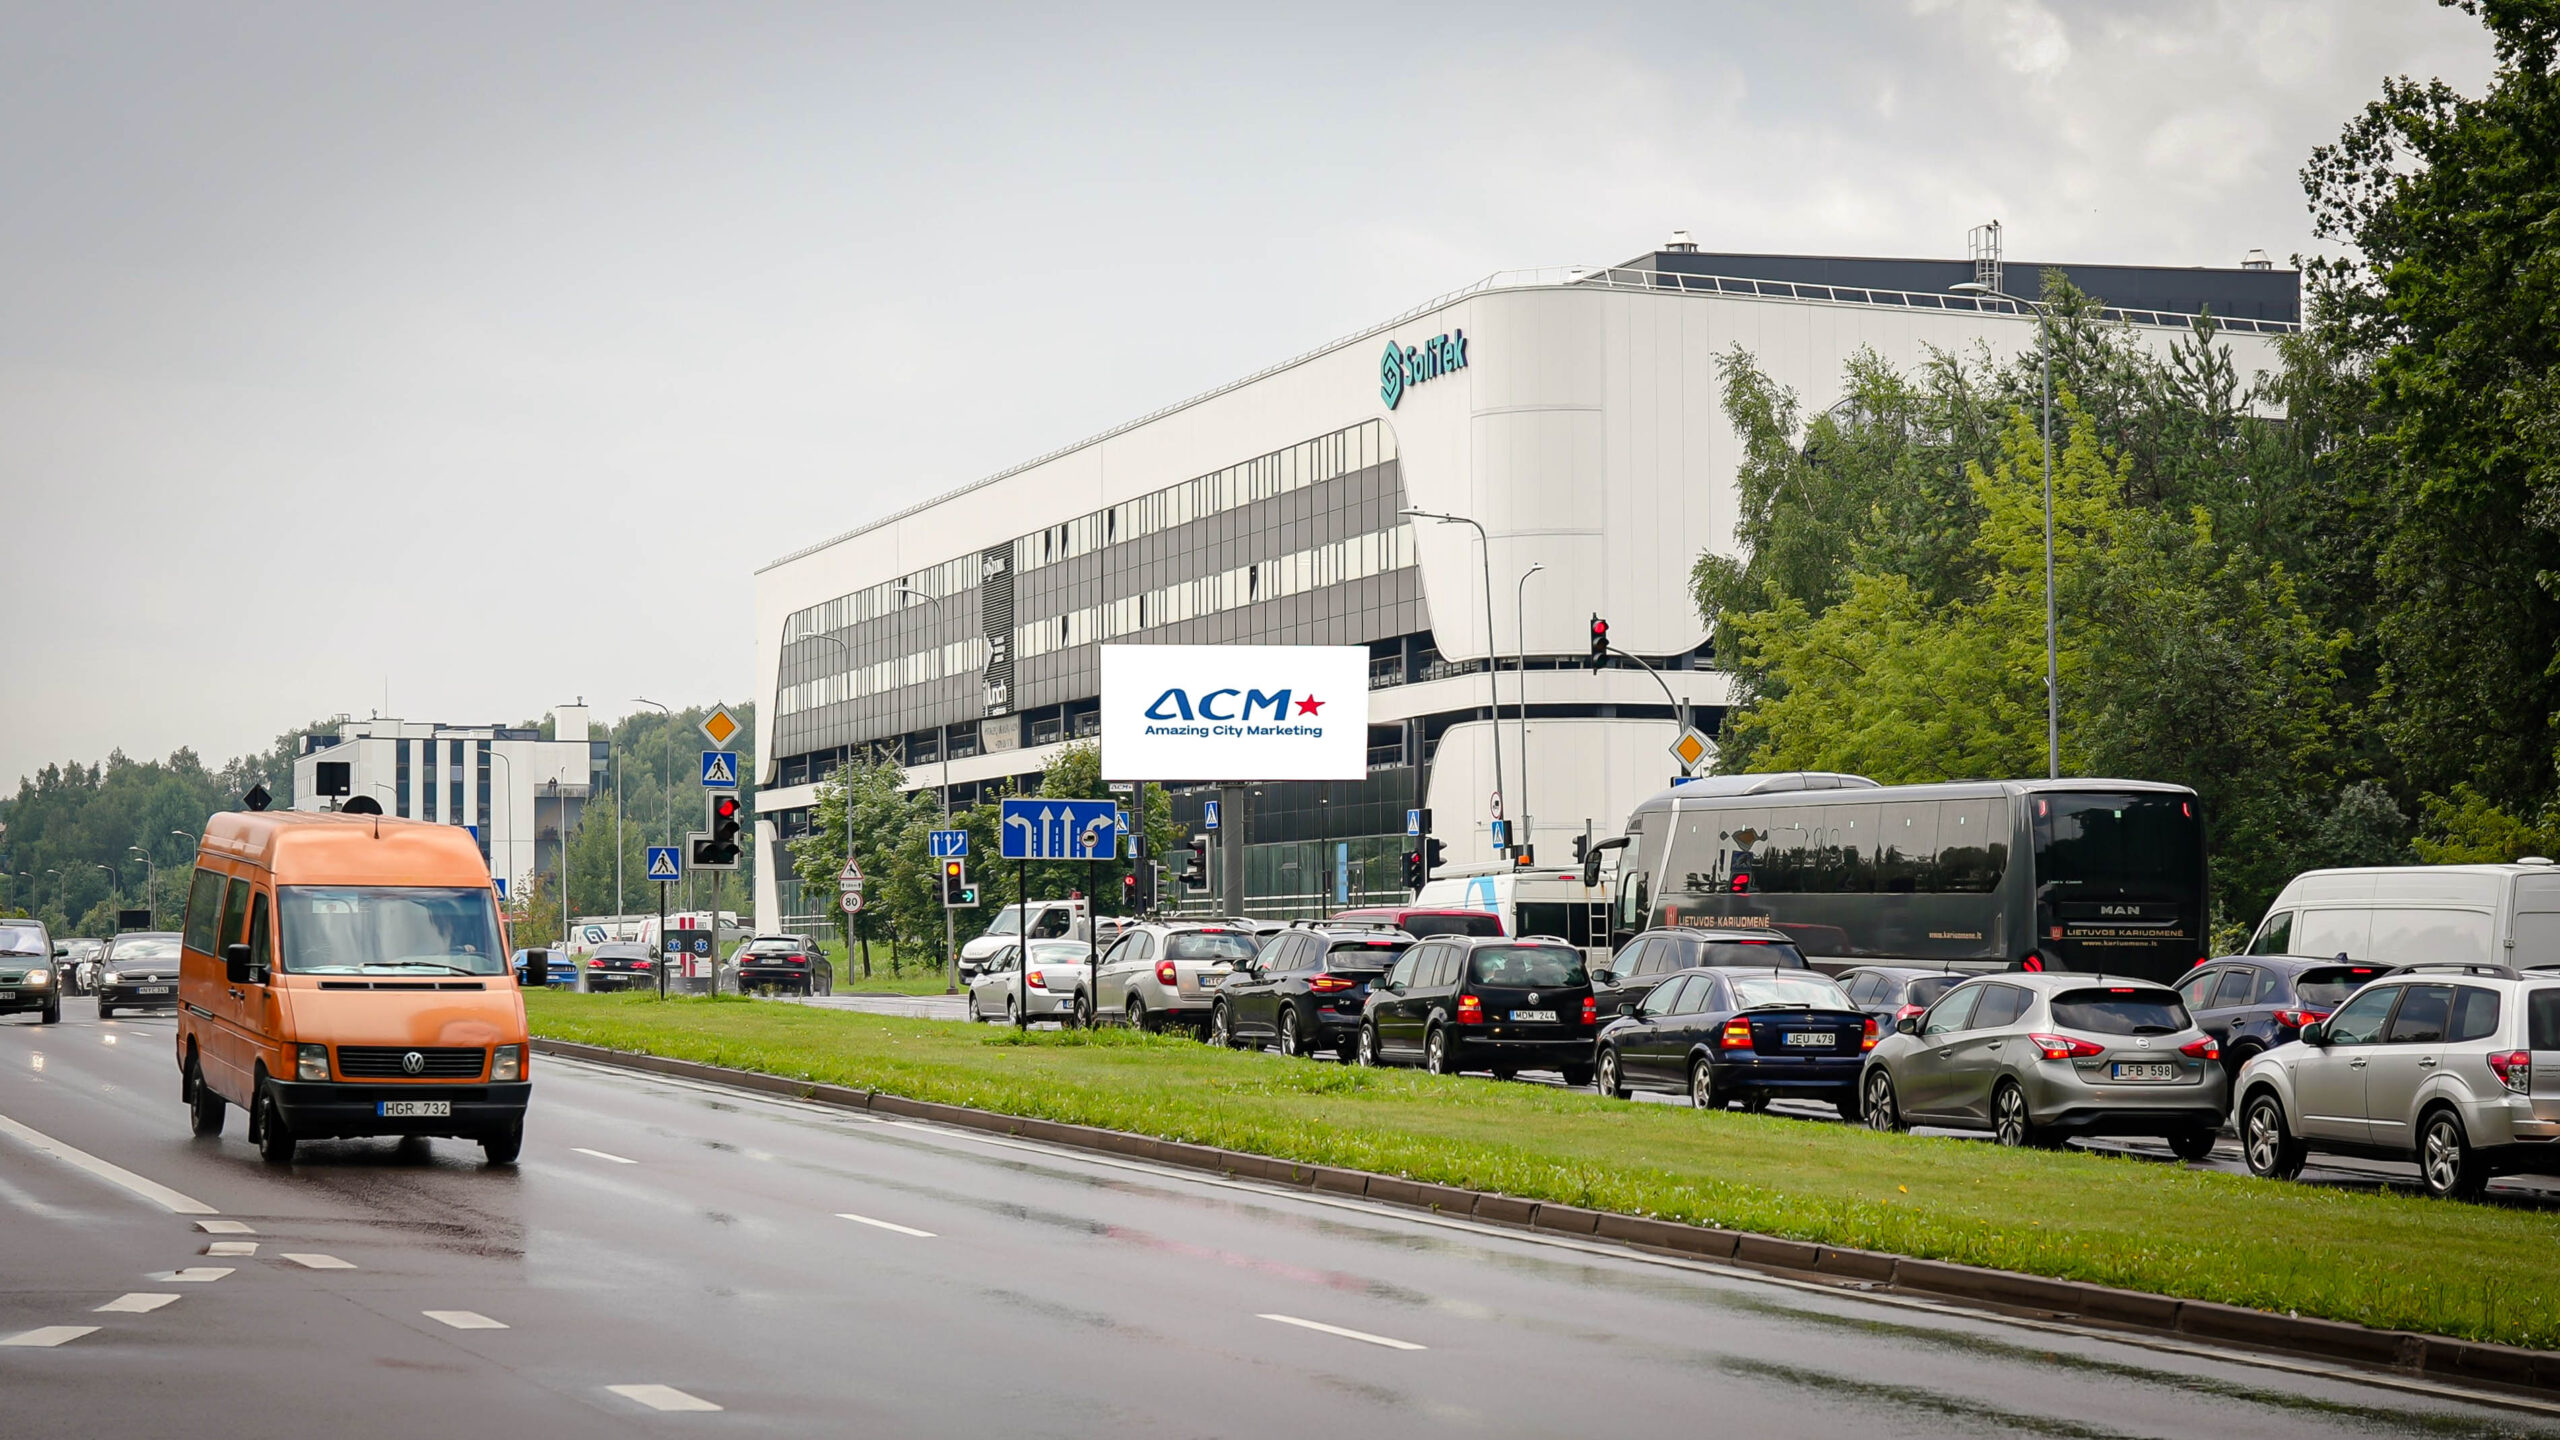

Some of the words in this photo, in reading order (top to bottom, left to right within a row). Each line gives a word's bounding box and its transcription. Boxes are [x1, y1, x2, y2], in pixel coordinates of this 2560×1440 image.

[1404, 328, 1468, 386] SoliTek
[1144, 688, 1292, 721] ACM
[1145, 725, 1209, 738] Amazing
[1212, 725, 1243, 738] City
[1247, 725, 1323, 738] Marketing
[845, 897, 858, 907] 80
[2101, 905, 2140, 915] MAN
[1678, 915, 1715, 926] LIETUVOS
[1515, 1011, 1534, 1019] MDM
[1540, 1011, 1555, 1019] 244
[1789, 1034, 1810, 1044] JEU
[1815, 1034, 1834, 1044] 479
[2120, 1065, 2144, 1076] LFB
[2151, 1065, 2171, 1076] 598
[385, 1103, 415, 1115] HGR
[423, 1103, 448, 1115] 732
